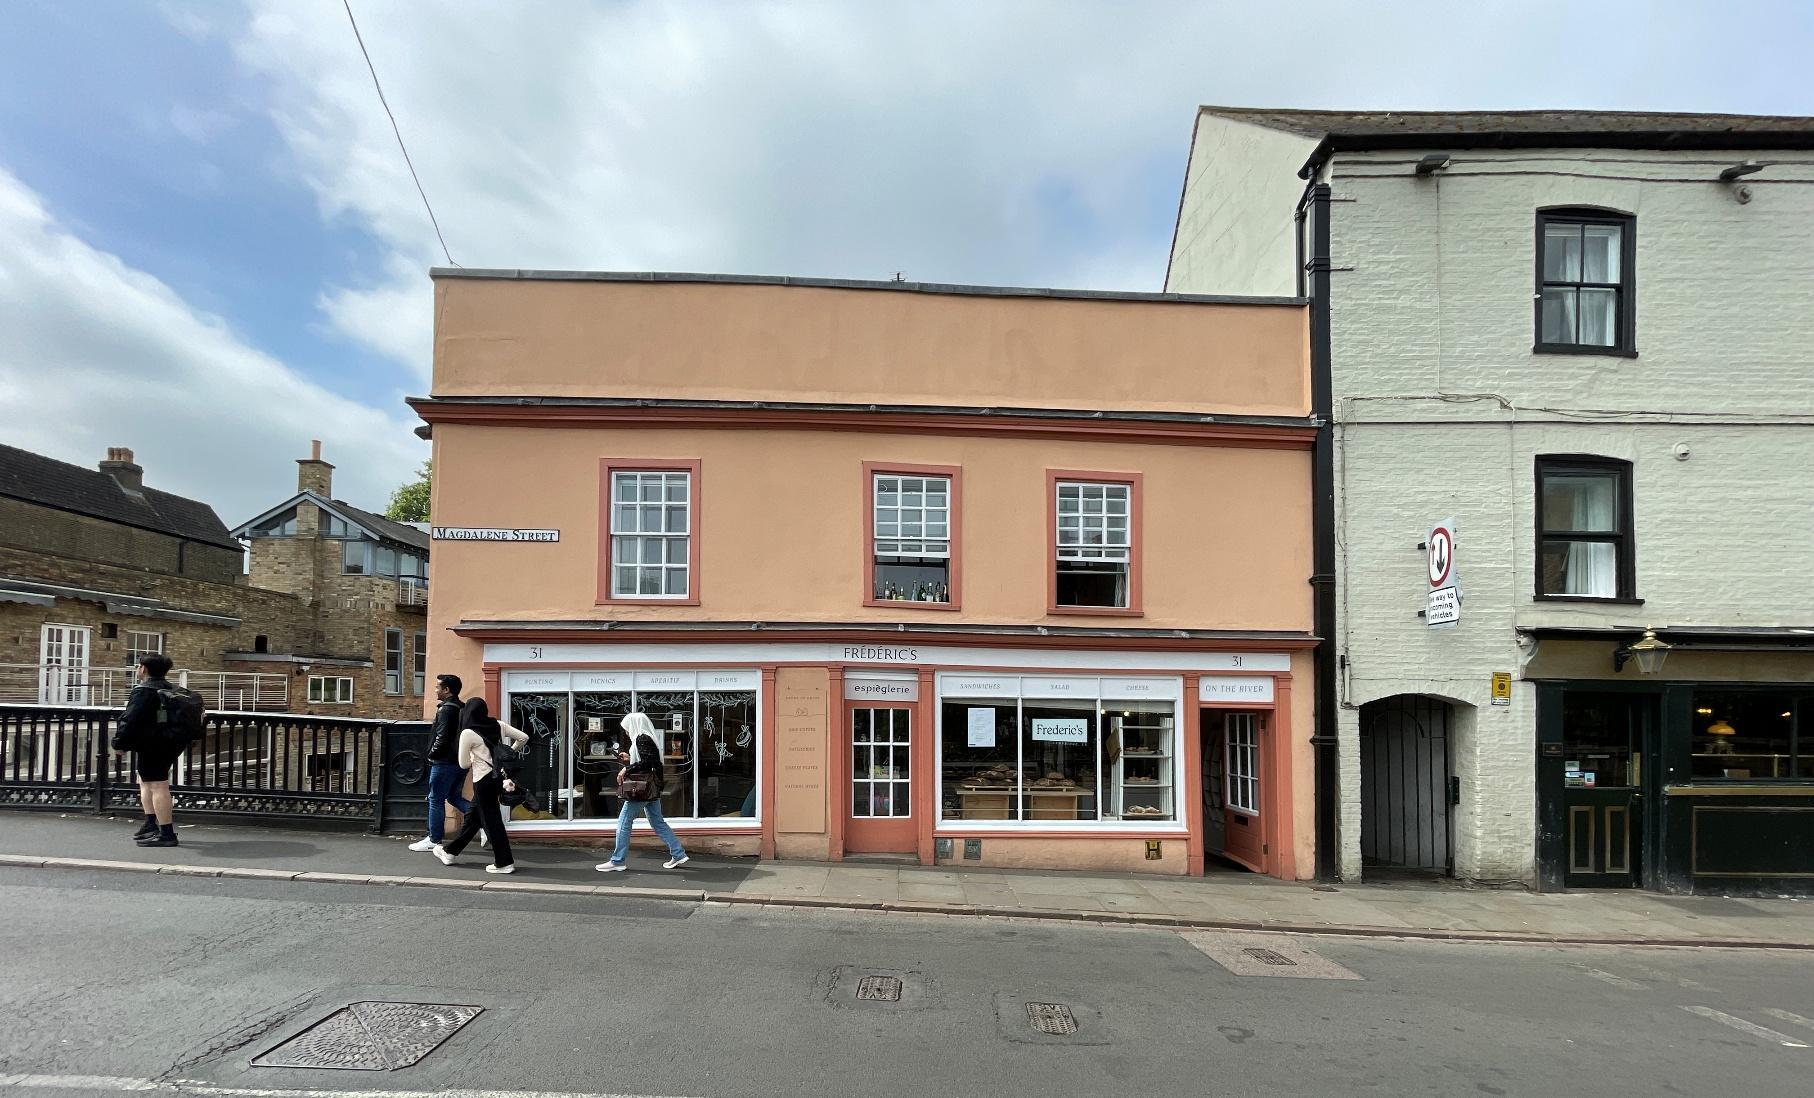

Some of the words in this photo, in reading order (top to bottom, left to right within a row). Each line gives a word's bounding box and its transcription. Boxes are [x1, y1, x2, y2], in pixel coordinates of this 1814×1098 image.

[436, 527, 508, 540] MAGDALENE
[512, 529, 556, 541] STREET
[1430, 602, 1454, 611] coming
[529, 646, 542, 659] 31
[844, 645, 918, 660] FRÉDÉRIC'S
[1231, 655, 1242, 667] 31
[854, 684, 910, 695] espièglerie
[1205, 684, 1217, 692] ON
[1220, 684, 1236, 692] THE
[1239, 685, 1264, 693] RIVER
[1036, 724, 1083, 735] Frederic's
